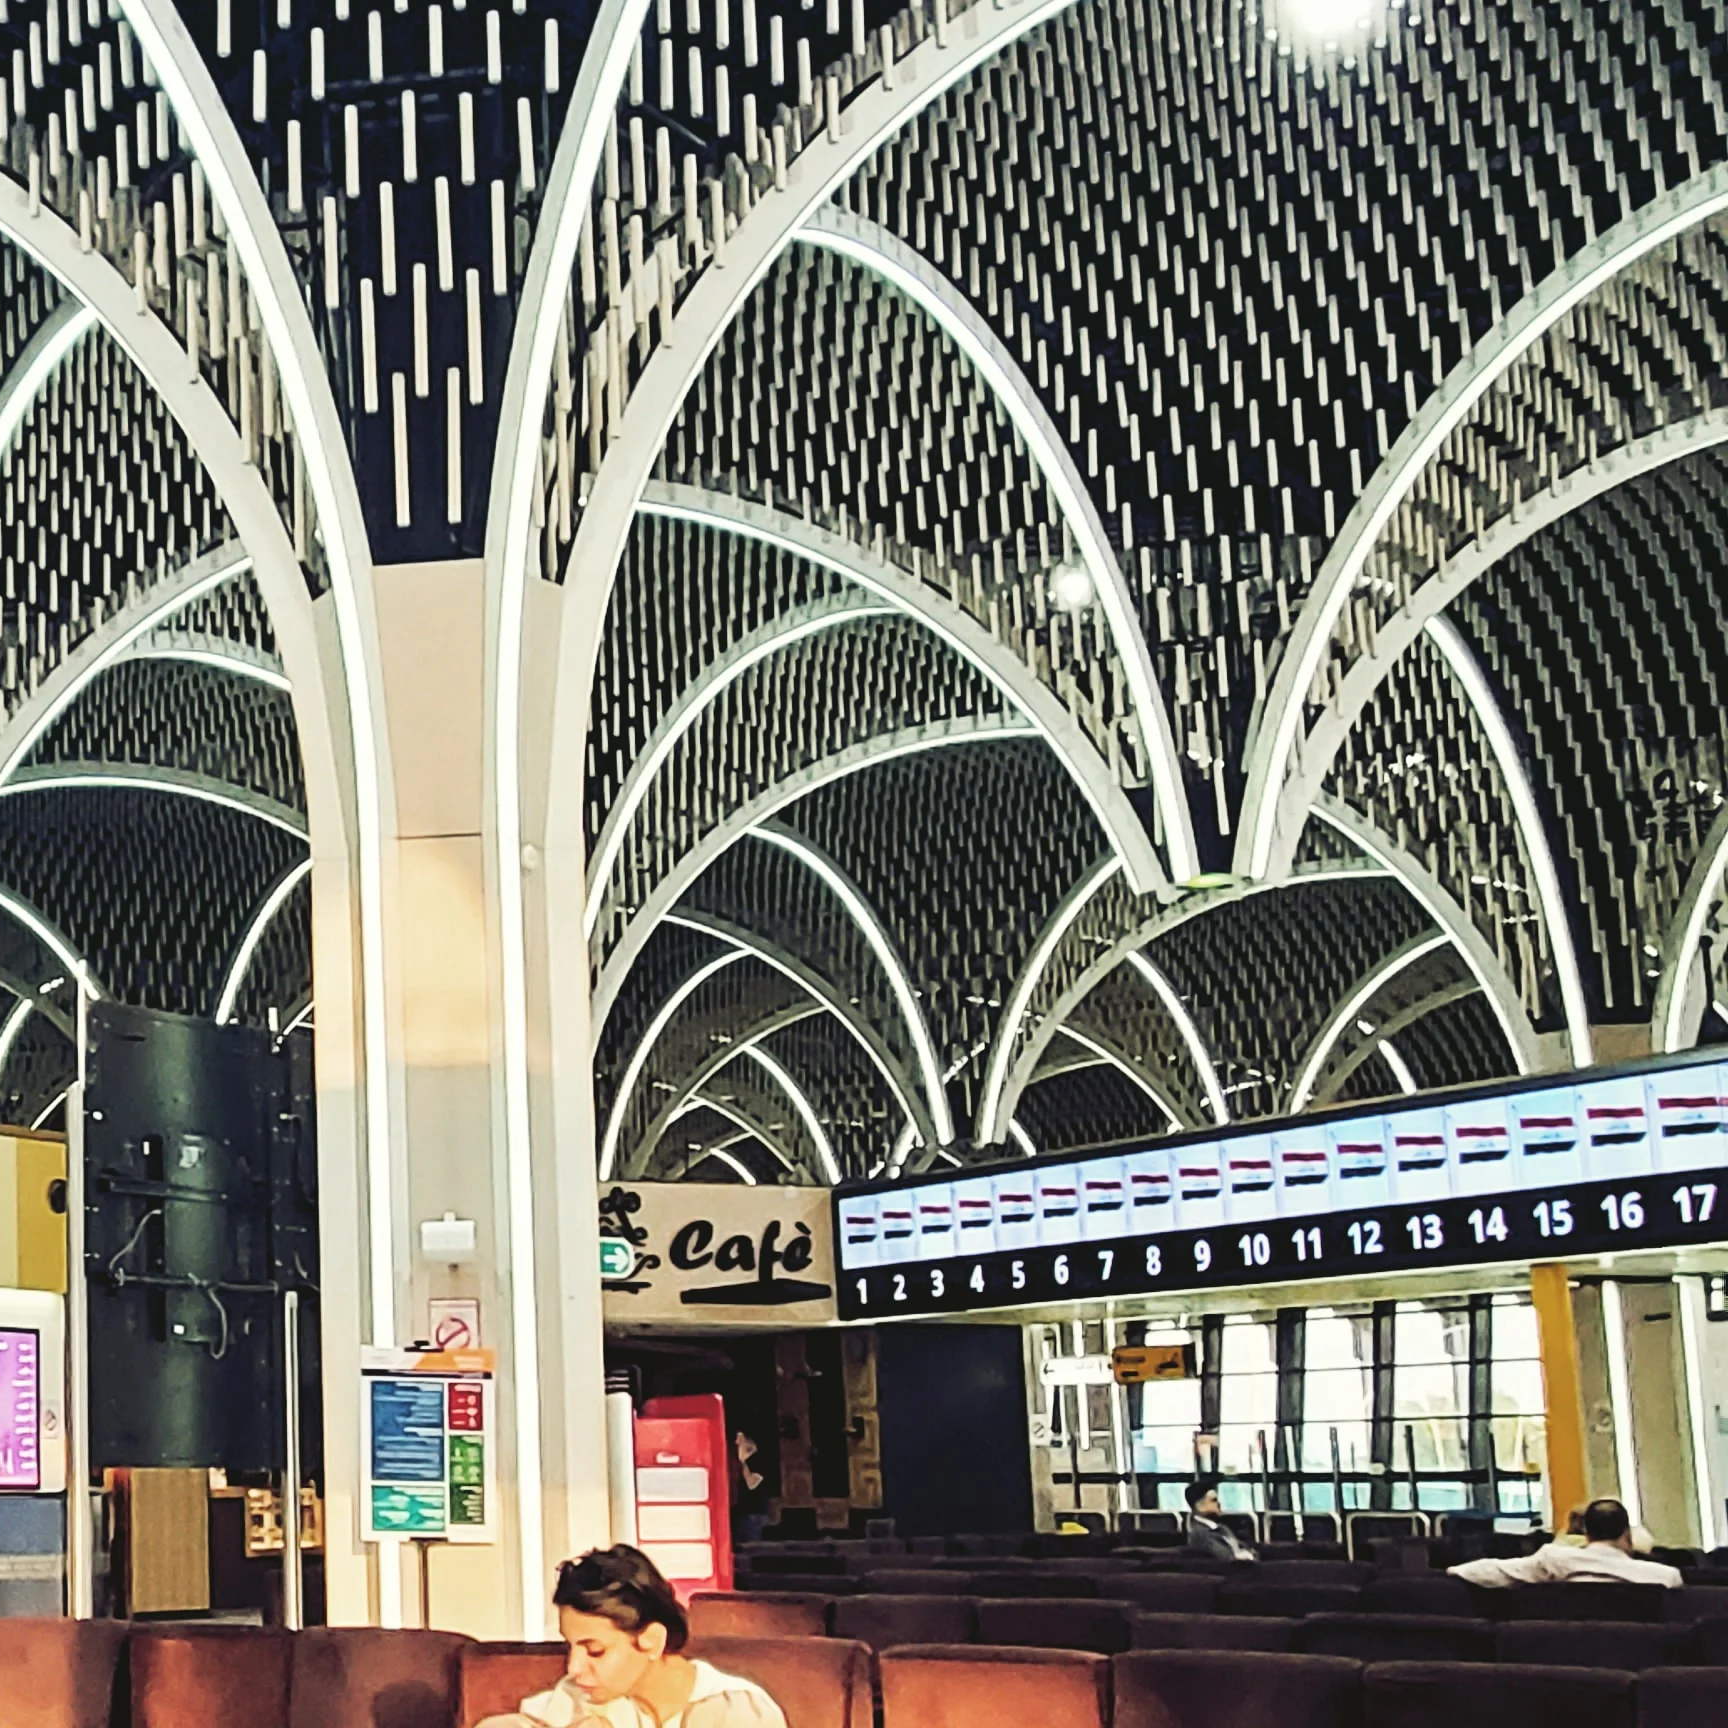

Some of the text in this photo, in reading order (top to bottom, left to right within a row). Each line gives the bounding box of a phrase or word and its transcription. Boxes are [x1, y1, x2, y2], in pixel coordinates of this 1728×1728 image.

[669, 1219, 813, 1281] Cafè
[856, 1184, 1717, 1304] 1 2 3 4 5 6 7 8 9 10 11 12 13 14 15 16 17
